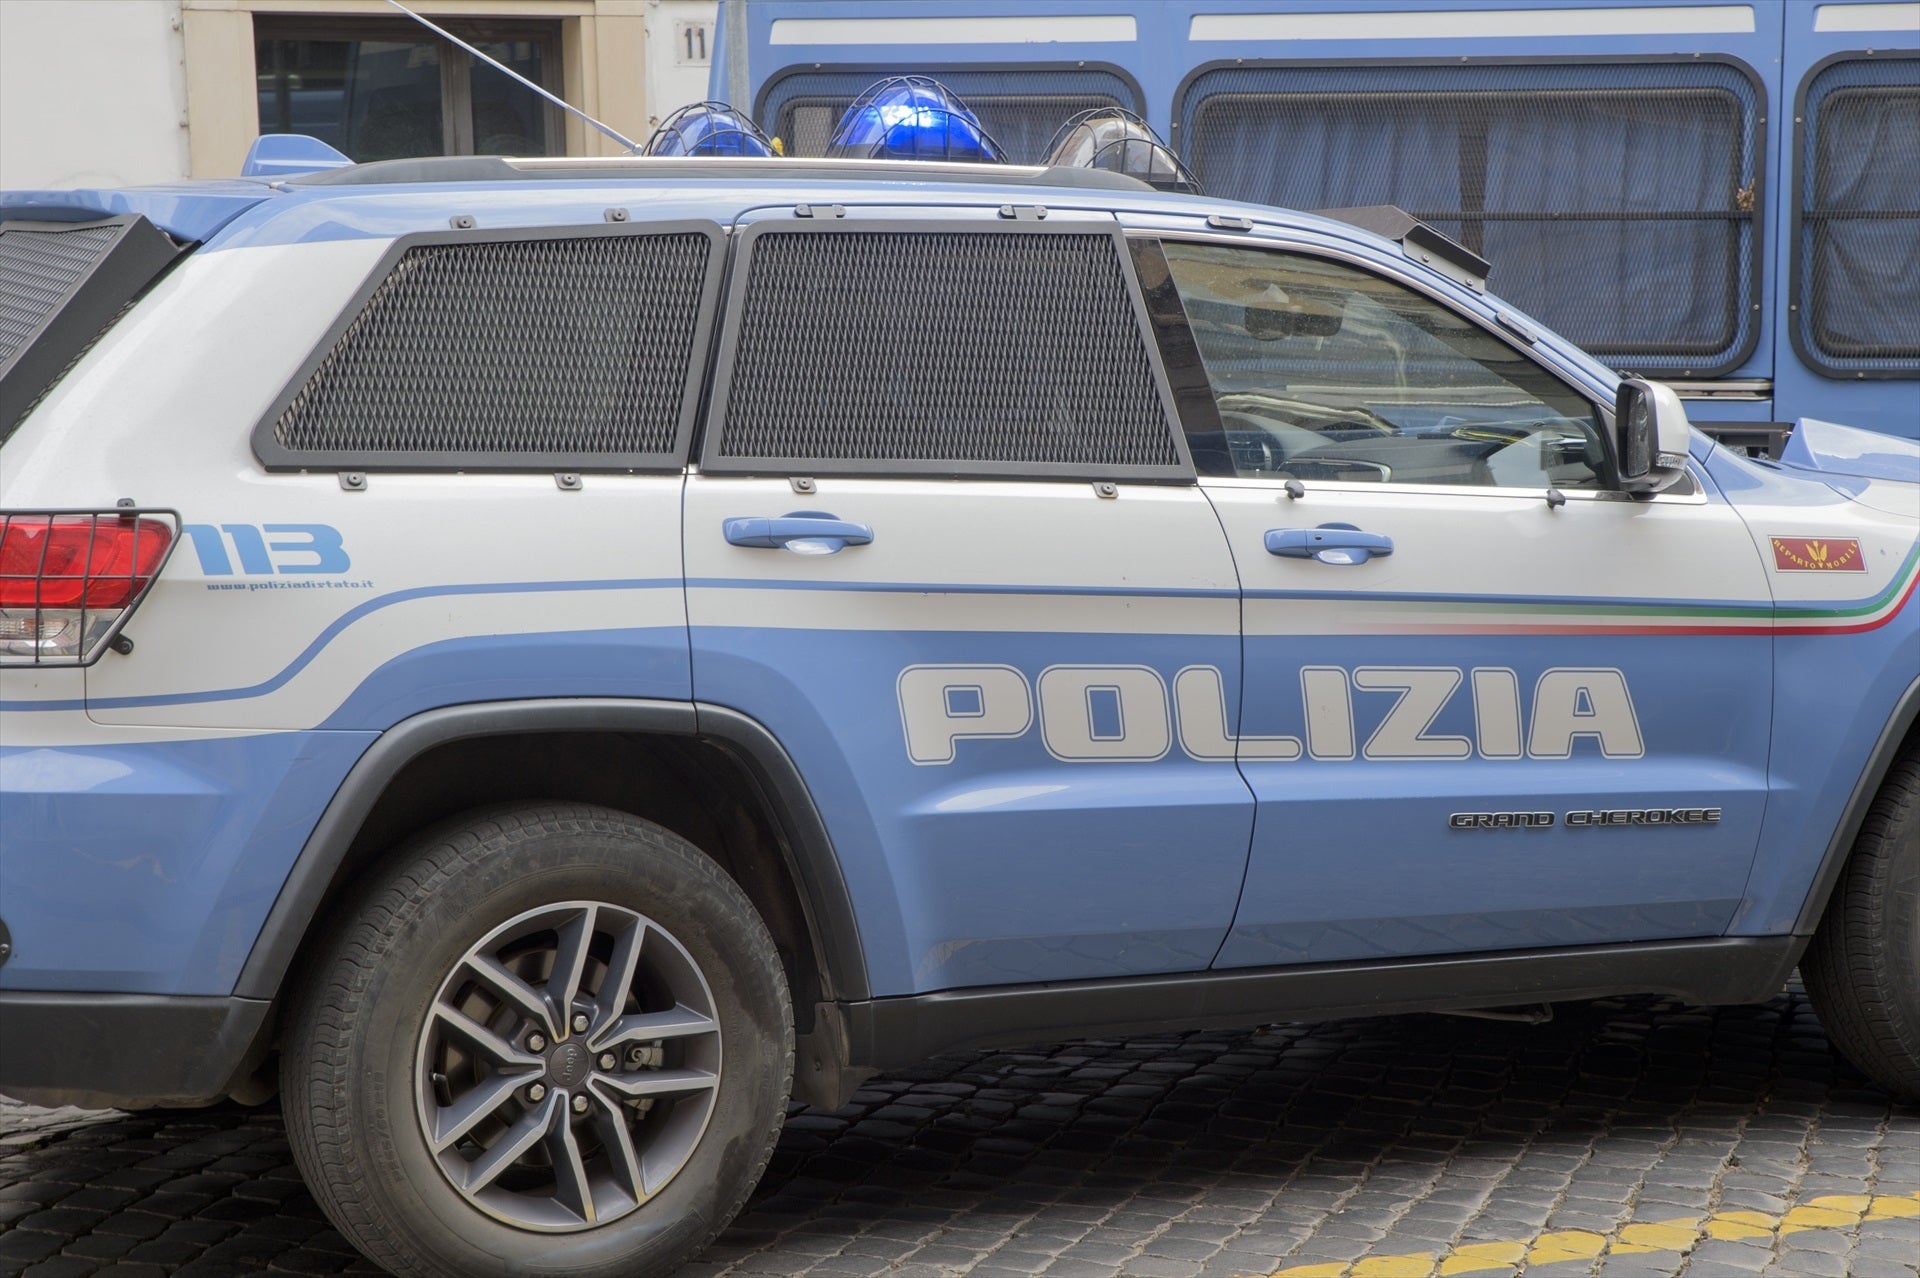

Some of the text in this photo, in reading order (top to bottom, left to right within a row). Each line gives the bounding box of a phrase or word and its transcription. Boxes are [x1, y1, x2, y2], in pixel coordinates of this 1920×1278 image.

[685, 28, 705, 59] 11
[182, 524, 351, 575] 113
[1773, 540, 1857, 569] REPARTO MOBILE
[896, 664, 1645, 766] POLIZIA
[1449, 808, 1721, 828] GRAND CHEROKEE
